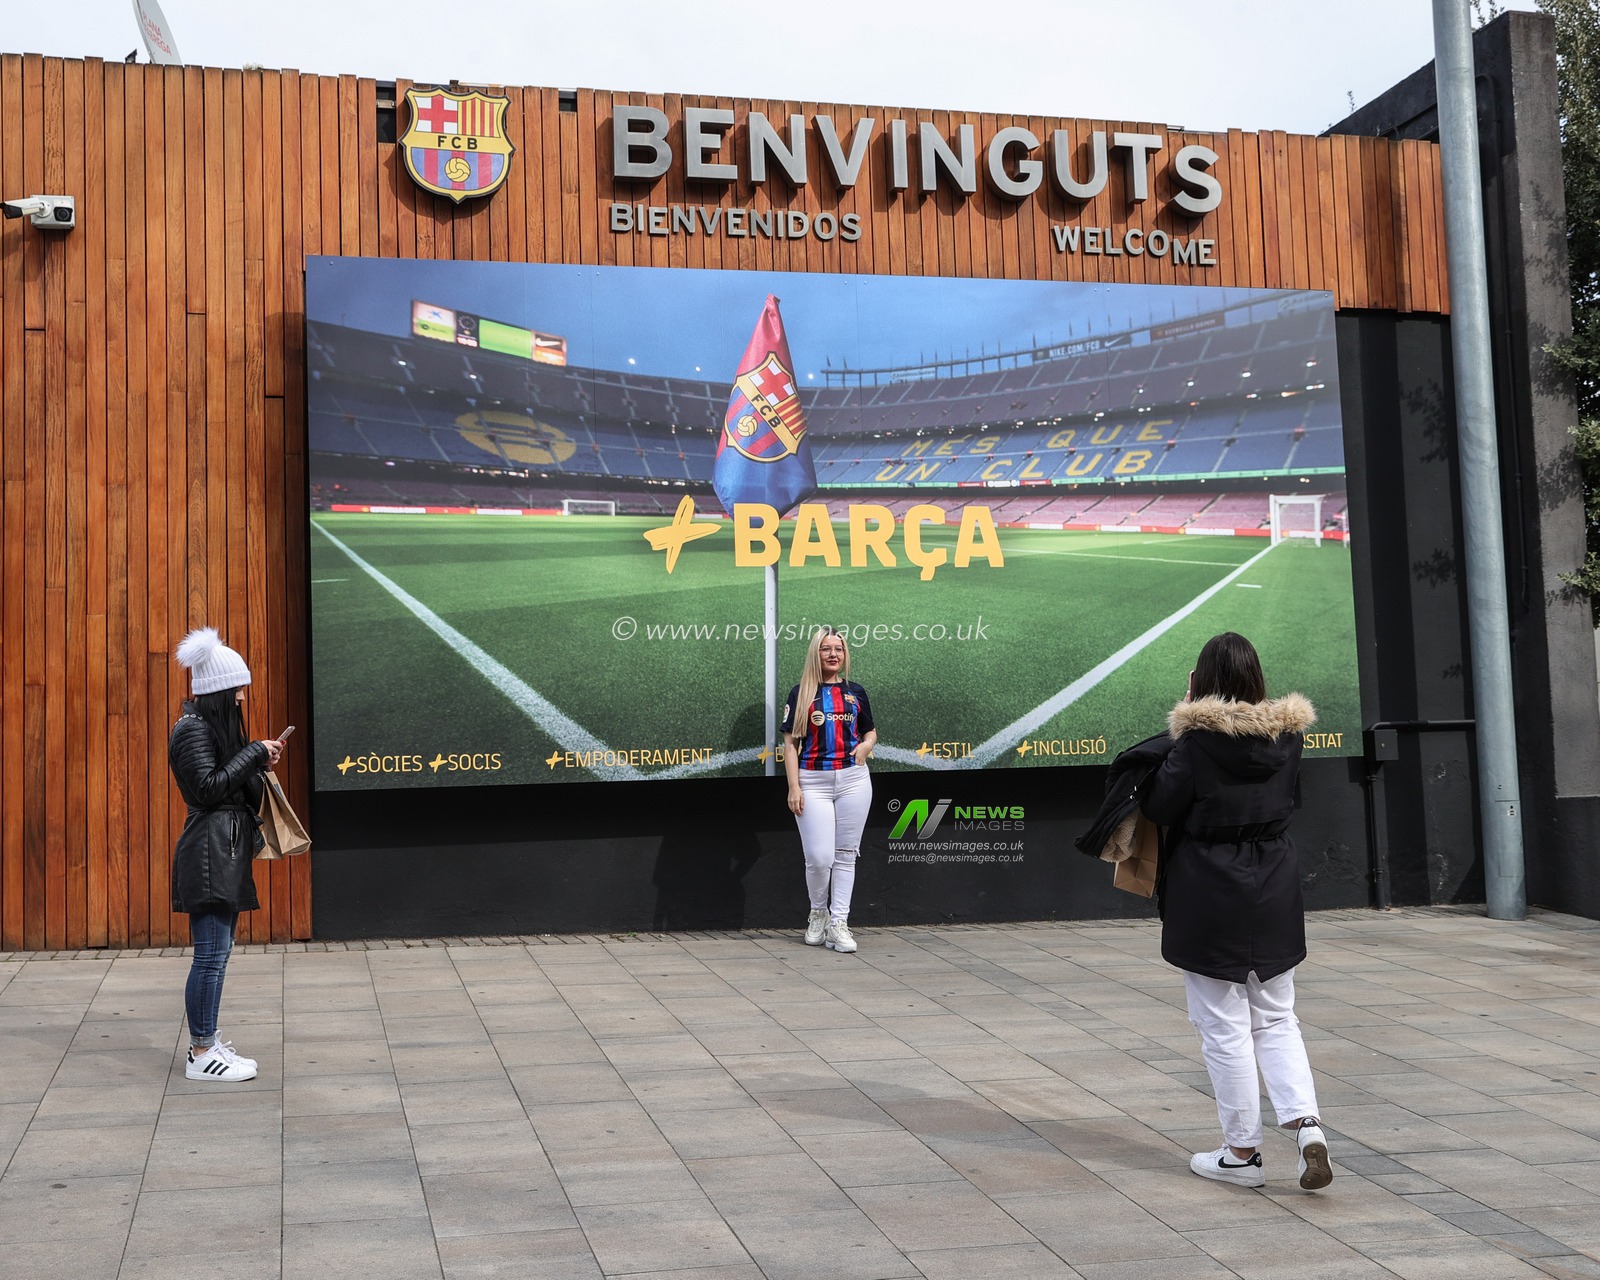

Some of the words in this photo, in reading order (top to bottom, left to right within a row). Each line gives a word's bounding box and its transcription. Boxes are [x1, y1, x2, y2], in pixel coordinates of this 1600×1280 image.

[437, 135, 478, 150] FCB
[612, 104, 1223, 217] BENVINGUTS
[609, 202, 863, 243] BIENVENIDOS
[1053, 224, 1218, 267] WELCOME
[1046, 420, 1174, 448] QUE
[875, 462, 940, 481] UN
[980, 451, 1153, 480] CLUB
[826, 712, 855, 723] Spotify
